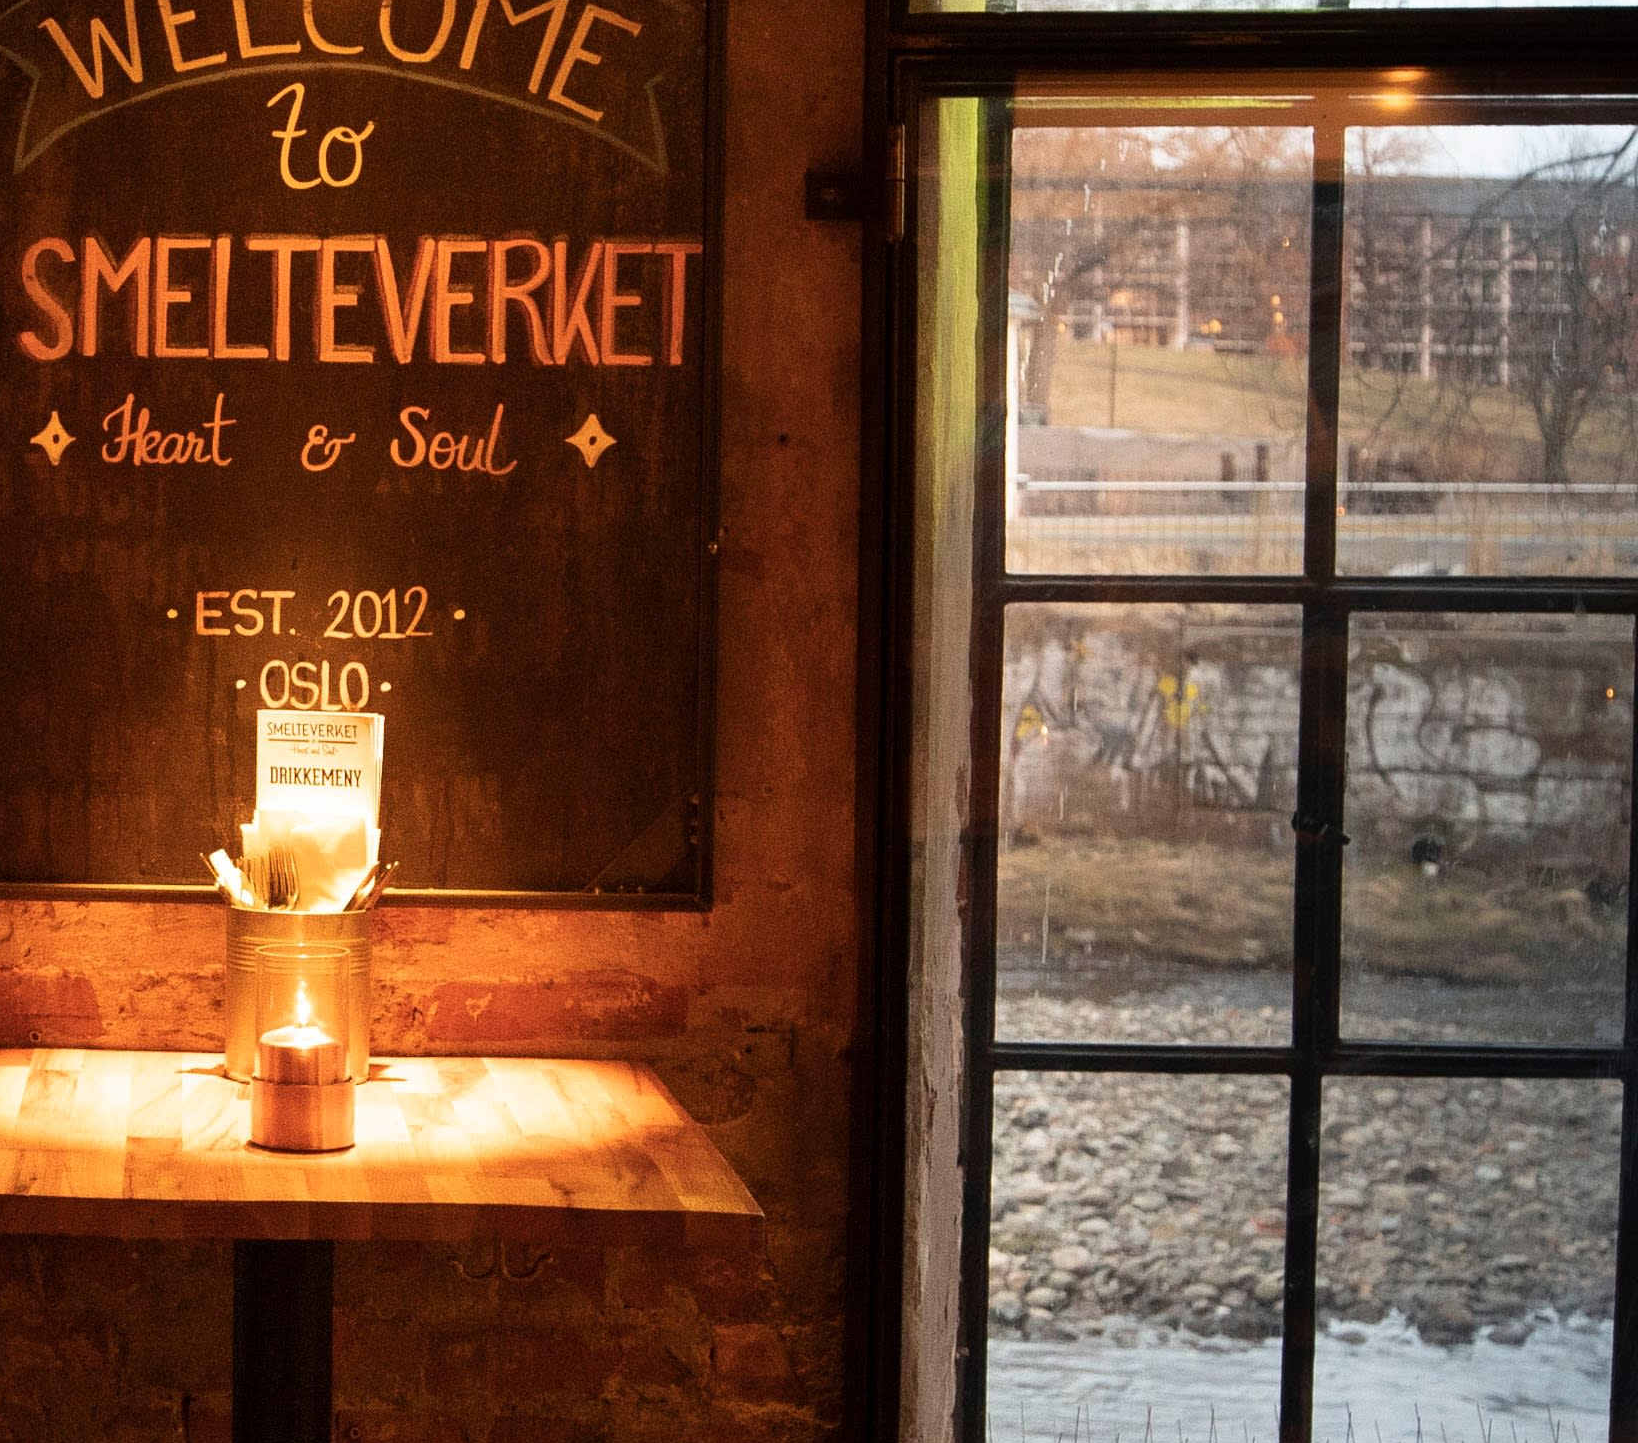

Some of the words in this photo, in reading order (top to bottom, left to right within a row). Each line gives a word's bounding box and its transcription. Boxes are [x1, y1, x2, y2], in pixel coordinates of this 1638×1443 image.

[266, 82, 375, 190] to
[18, 233, 703, 366] SMELTEVERKET
[101, 392, 238, 468] Heart
[301, 424, 356, 472] &
[390, 404, 517, 476] Soul
[196, 589, 297, 638] EST.
[324, 586, 433, 639] 2012
[259, 659, 370, 711] OSLO
[266, 721, 358, 739] SMELTEVERKET
[269, 766, 362, 788] DRIKKEMENY
